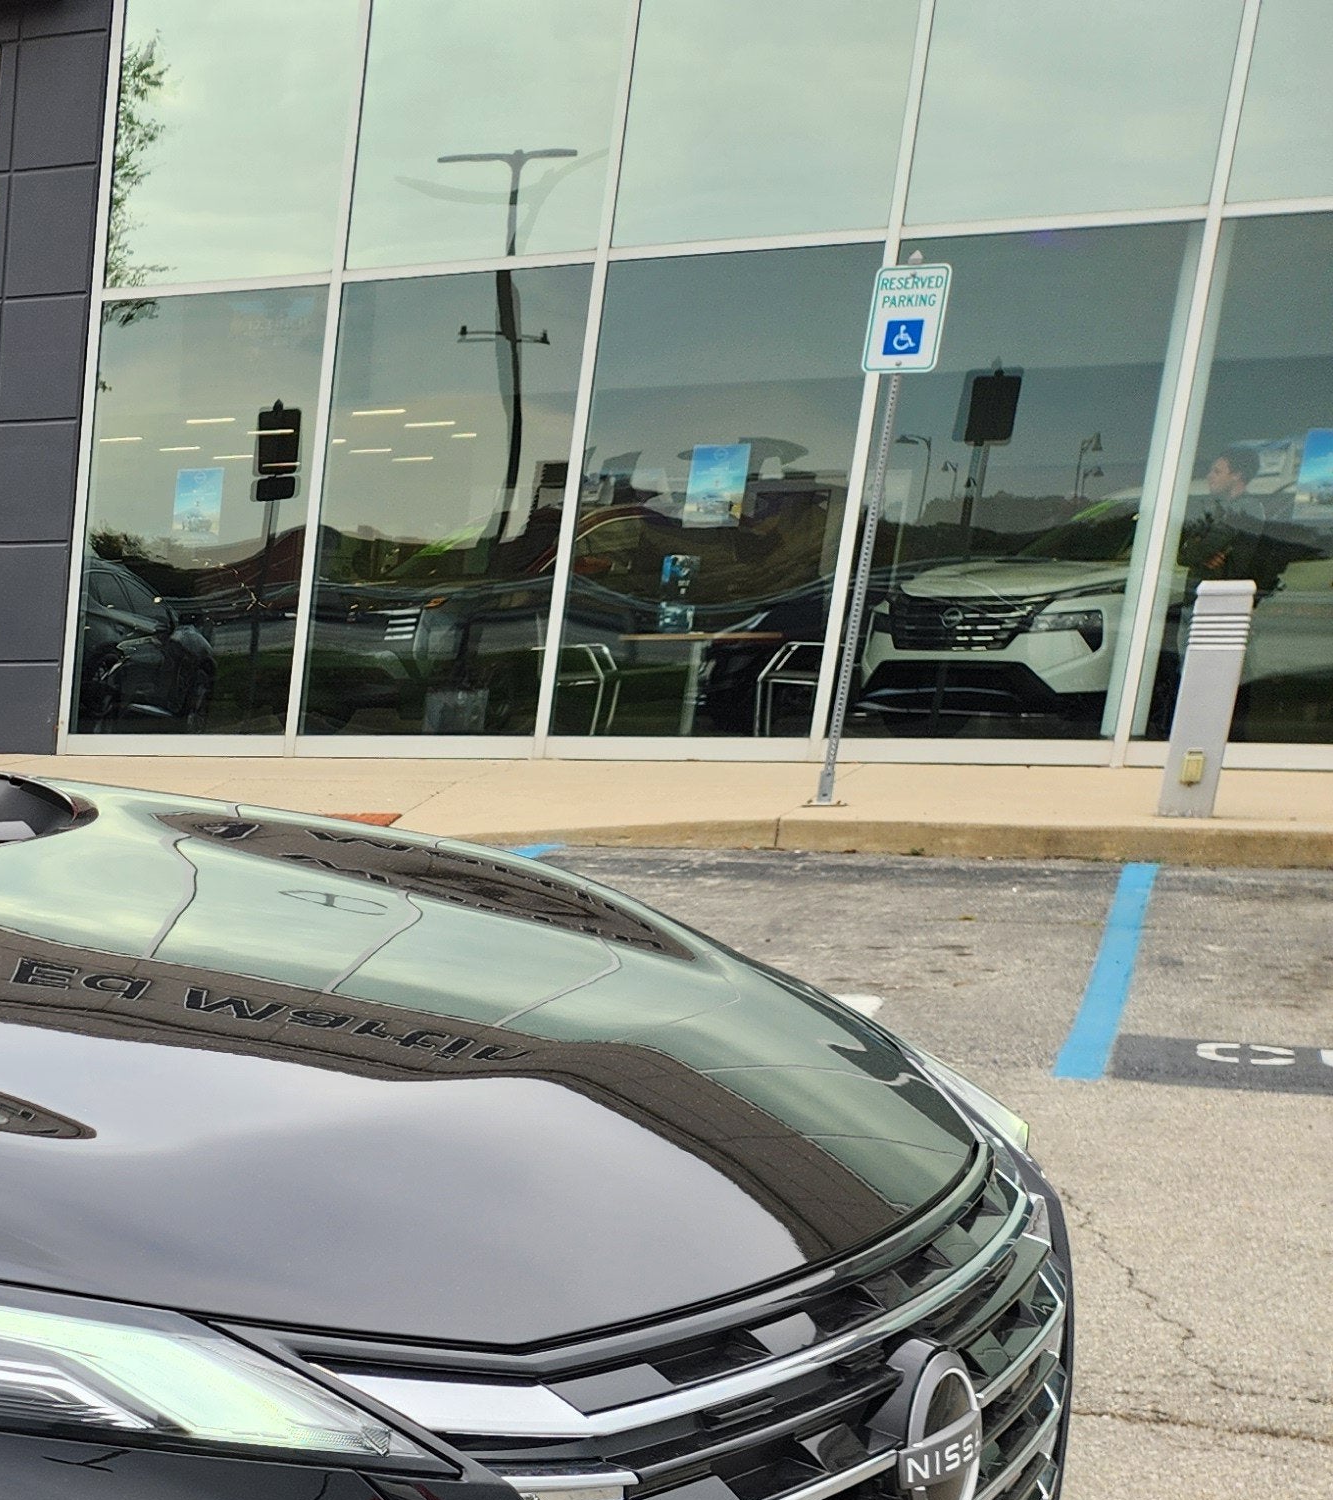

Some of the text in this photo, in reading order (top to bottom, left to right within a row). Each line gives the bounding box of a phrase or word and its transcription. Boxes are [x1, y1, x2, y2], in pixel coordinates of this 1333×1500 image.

[880, 275, 944, 291] RESERVED
[882, 294, 937, 309] PARKING
[906, 1427, 981, 1484] NISS
